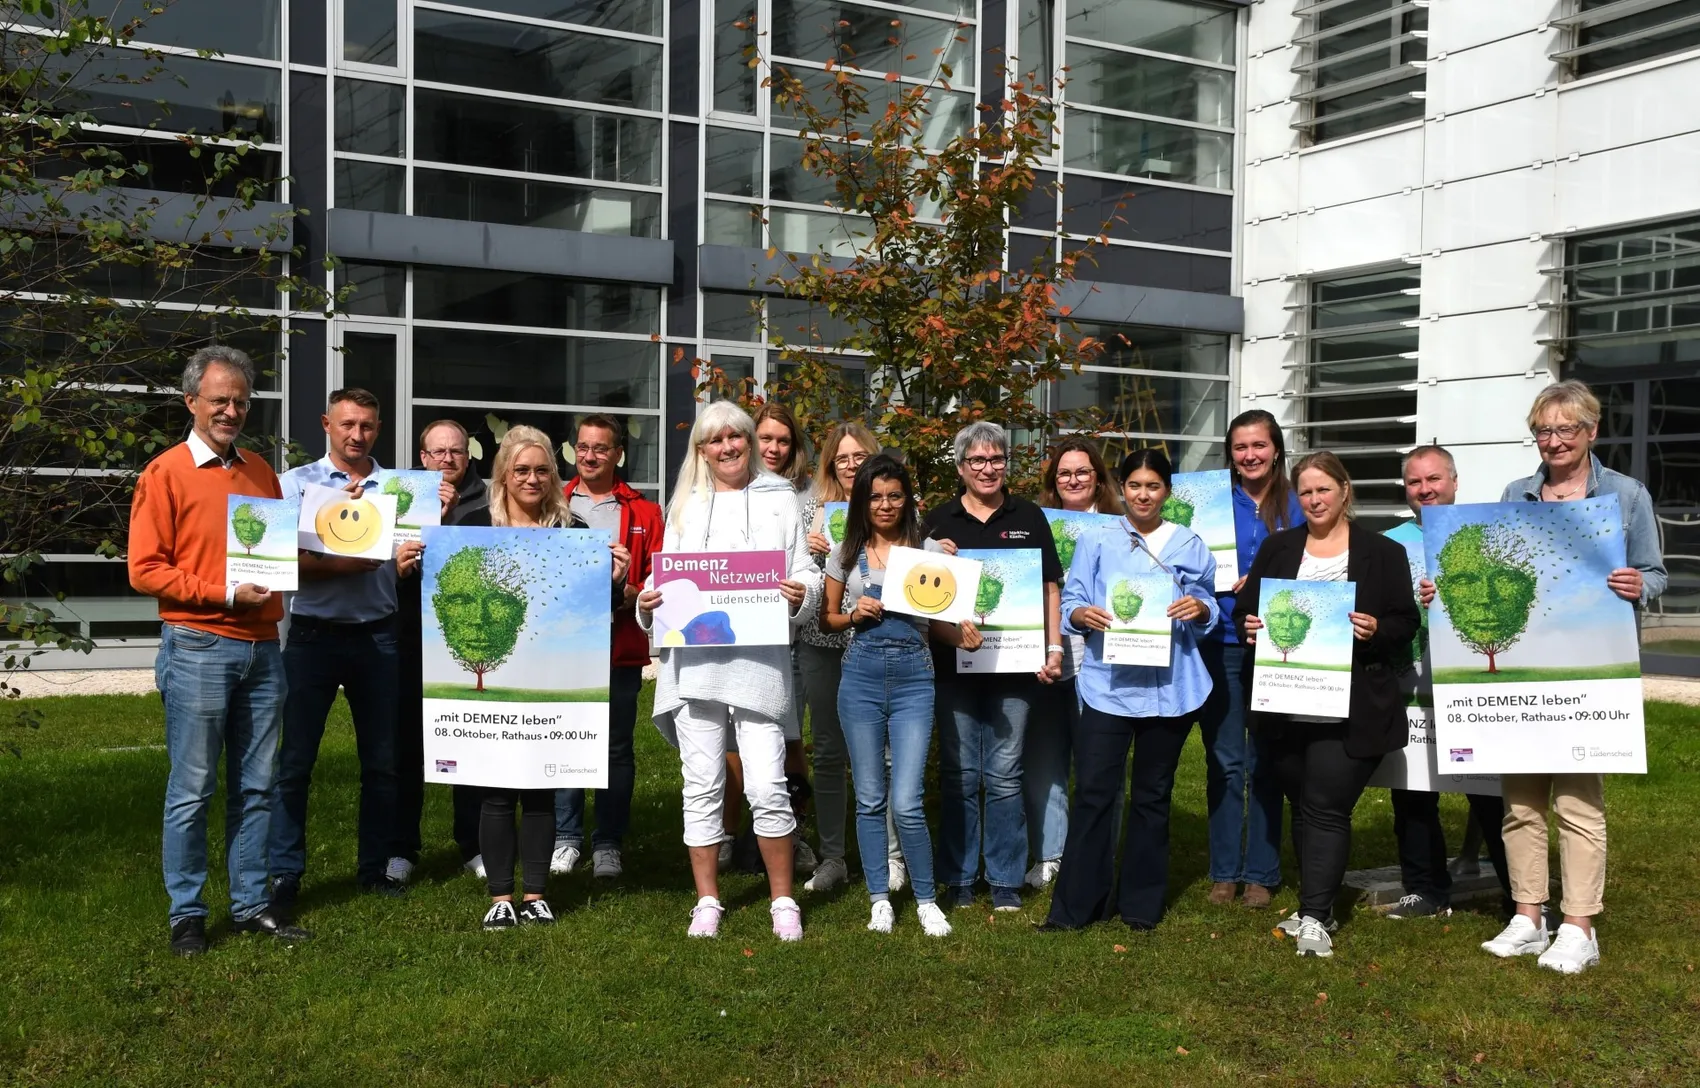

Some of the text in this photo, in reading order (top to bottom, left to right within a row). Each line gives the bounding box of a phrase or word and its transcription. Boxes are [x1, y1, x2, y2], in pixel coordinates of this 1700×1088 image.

[662, 557, 728, 571] Demenz
[709, 569, 780, 584] Netzwerk
[710, 593, 780, 605] Lüdenscheid
[1274, 673, 1304, 681] DEMENZ
[1447, 693, 1587, 708] „mit DEMENZ leben“
[434, 712, 562, 725] „mit DEMENZ leben“
[1447, 709, 1630, 723] 08. Oktober, Rathaus 09:00 Uhr
[434, 727, 598, 741] 08. Oktober, Rathaus 09:00 Uhr
[1410, 734, 1436, 745] Ratha
